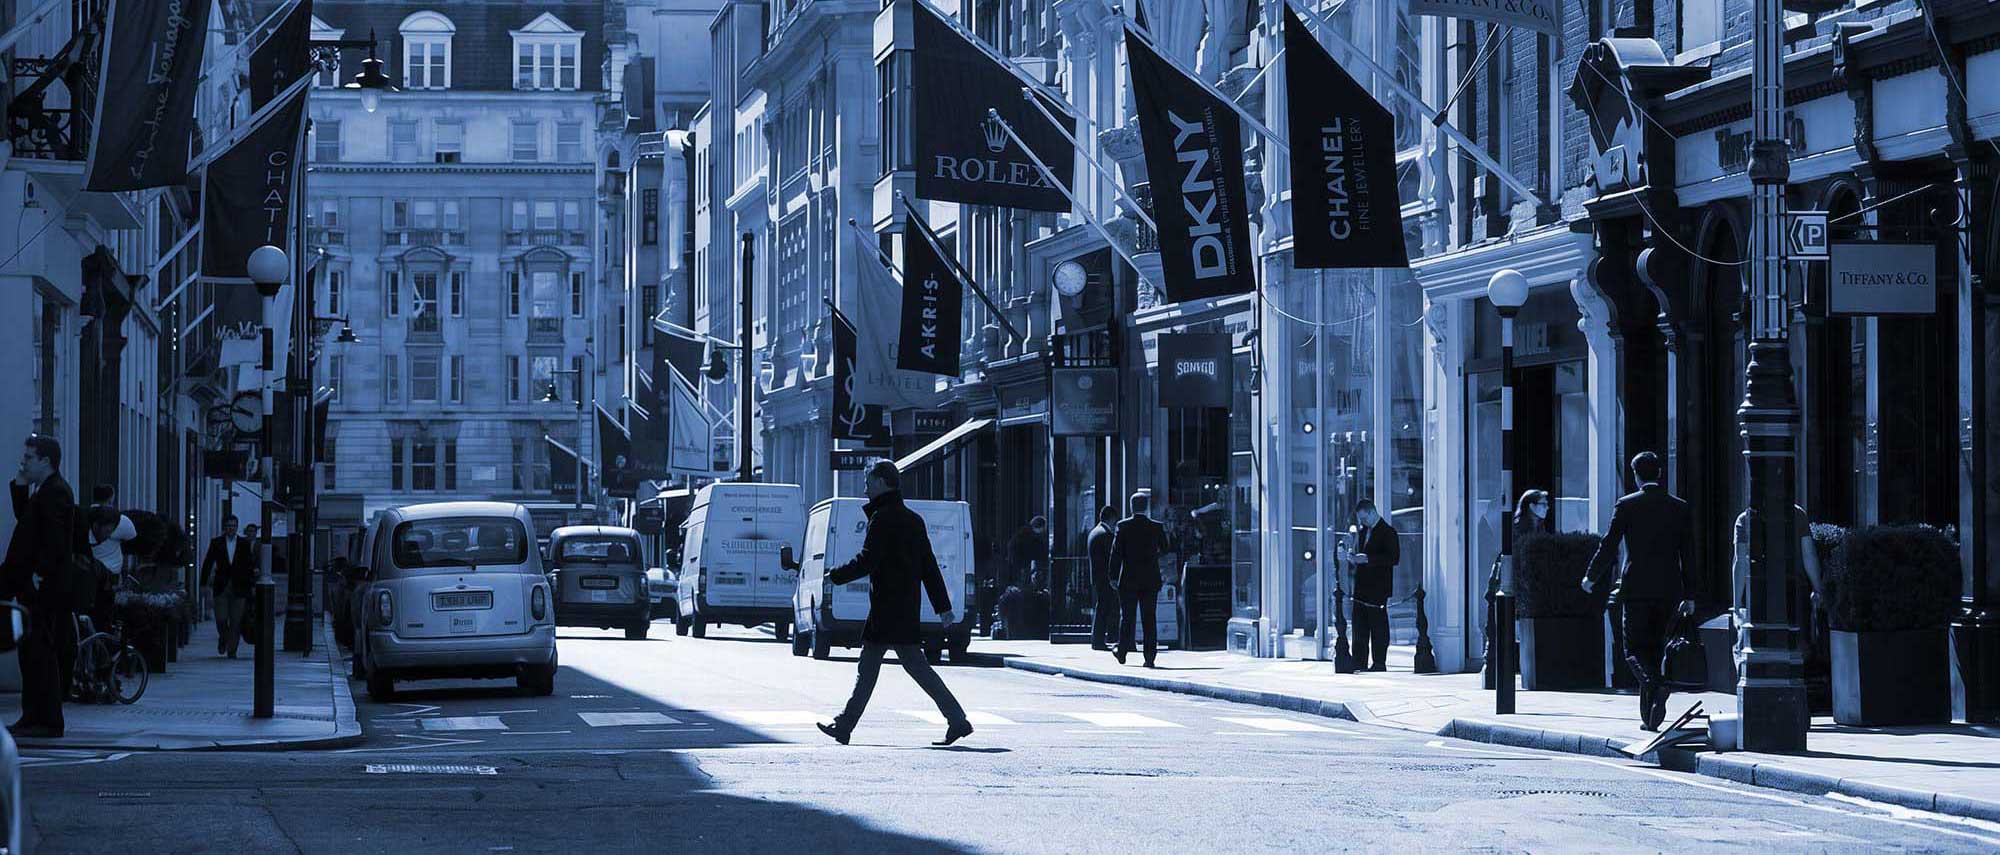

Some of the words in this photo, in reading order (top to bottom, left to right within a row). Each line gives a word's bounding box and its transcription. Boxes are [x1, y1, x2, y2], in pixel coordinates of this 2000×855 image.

[147, 0, 192, 84] Ferraga
[934, 155, 1056, 189] ROLEX
[1168, 110, 1228, 280] DKNY
[1321, 117, 1351, 240] CHANEL
[1349, 117, 1370, 196] JEWELLERY
[264, 151, 288, 243] CHATI
[1357, 200, 1370, 230] FINE
[1808, 226, 1821, 245] P
[1840, 271, 1894, 285] TIFFANY
